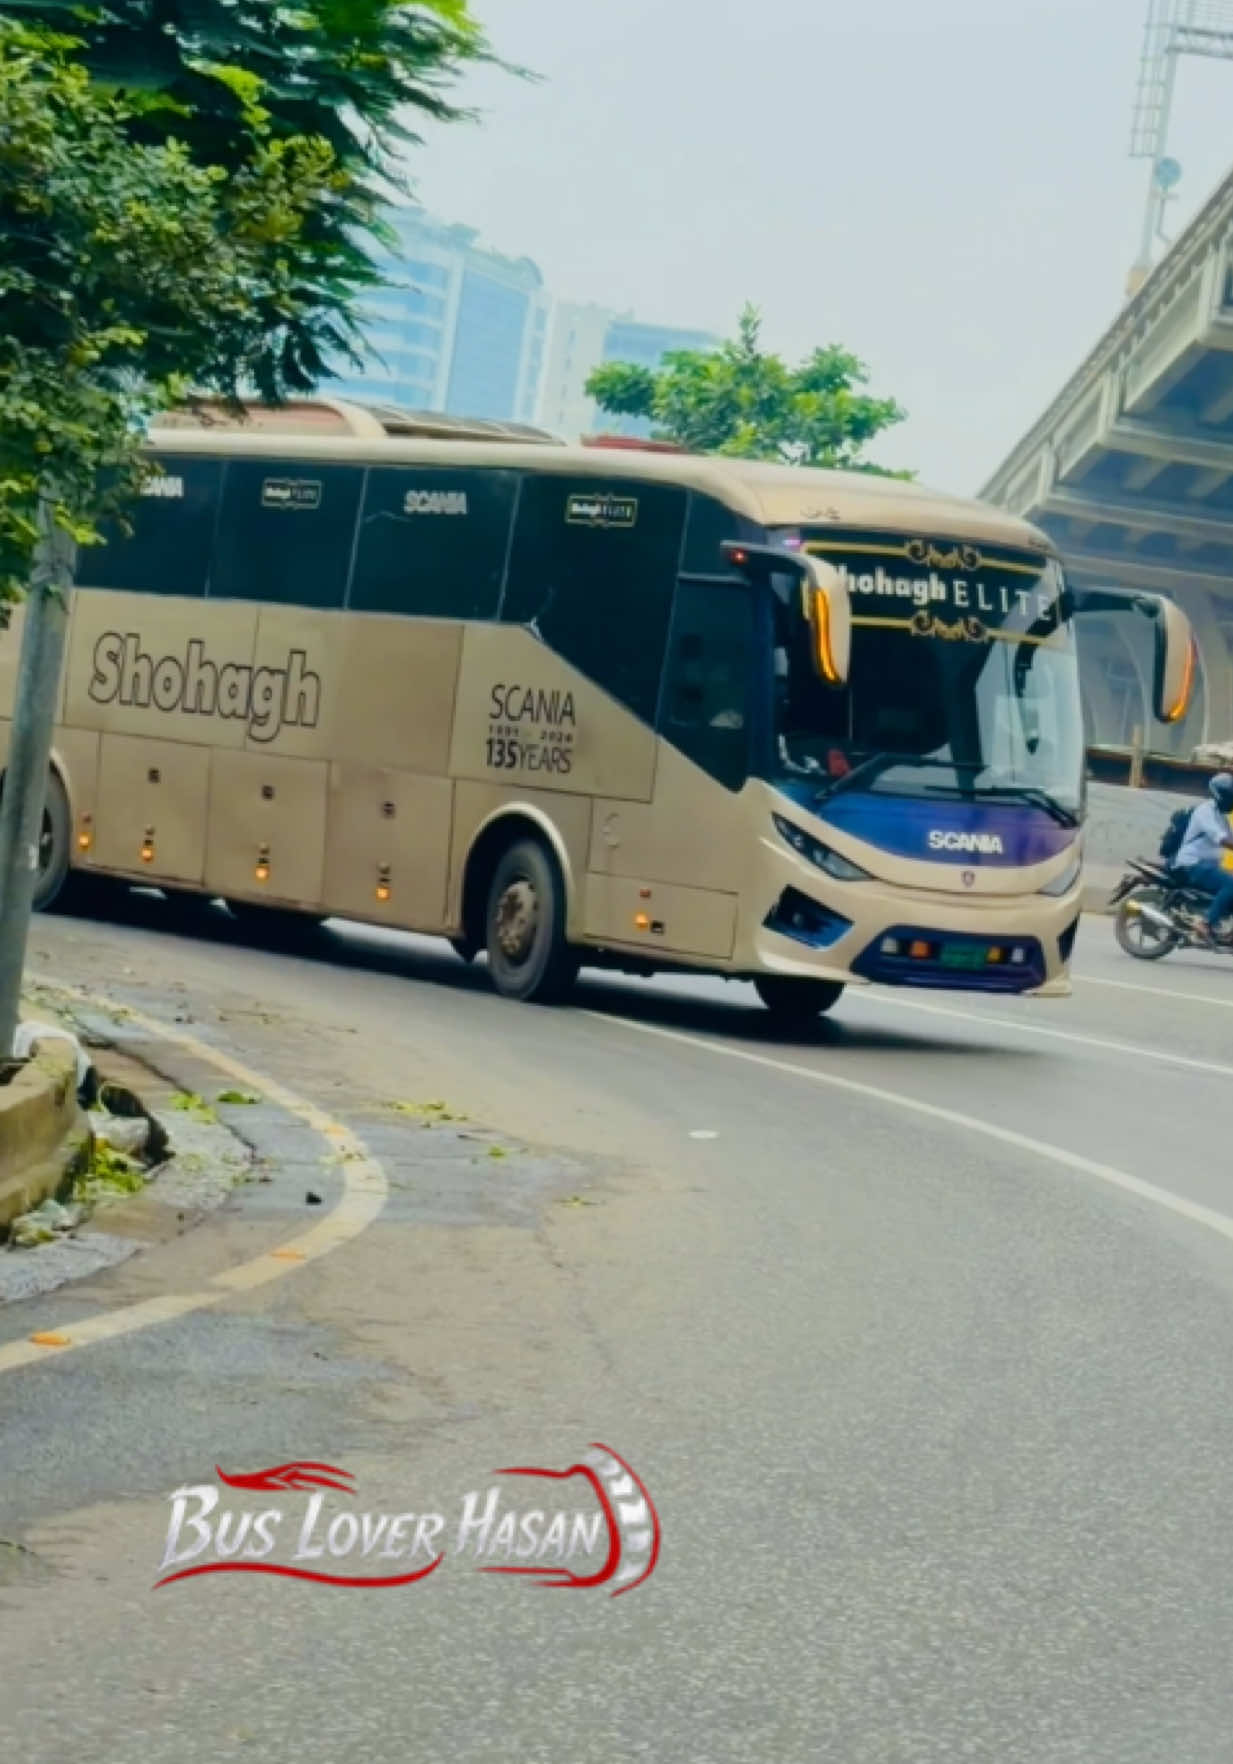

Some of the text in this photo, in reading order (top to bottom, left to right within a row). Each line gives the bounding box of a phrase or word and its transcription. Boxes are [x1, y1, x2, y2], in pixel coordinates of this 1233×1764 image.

[952, 578, 1052, 621] ELITE
[88, 630, 321, 743] Shohagh
[488, 683, 576, 728] SCANIA
[928, 828, 1004, 855] SCANIA
